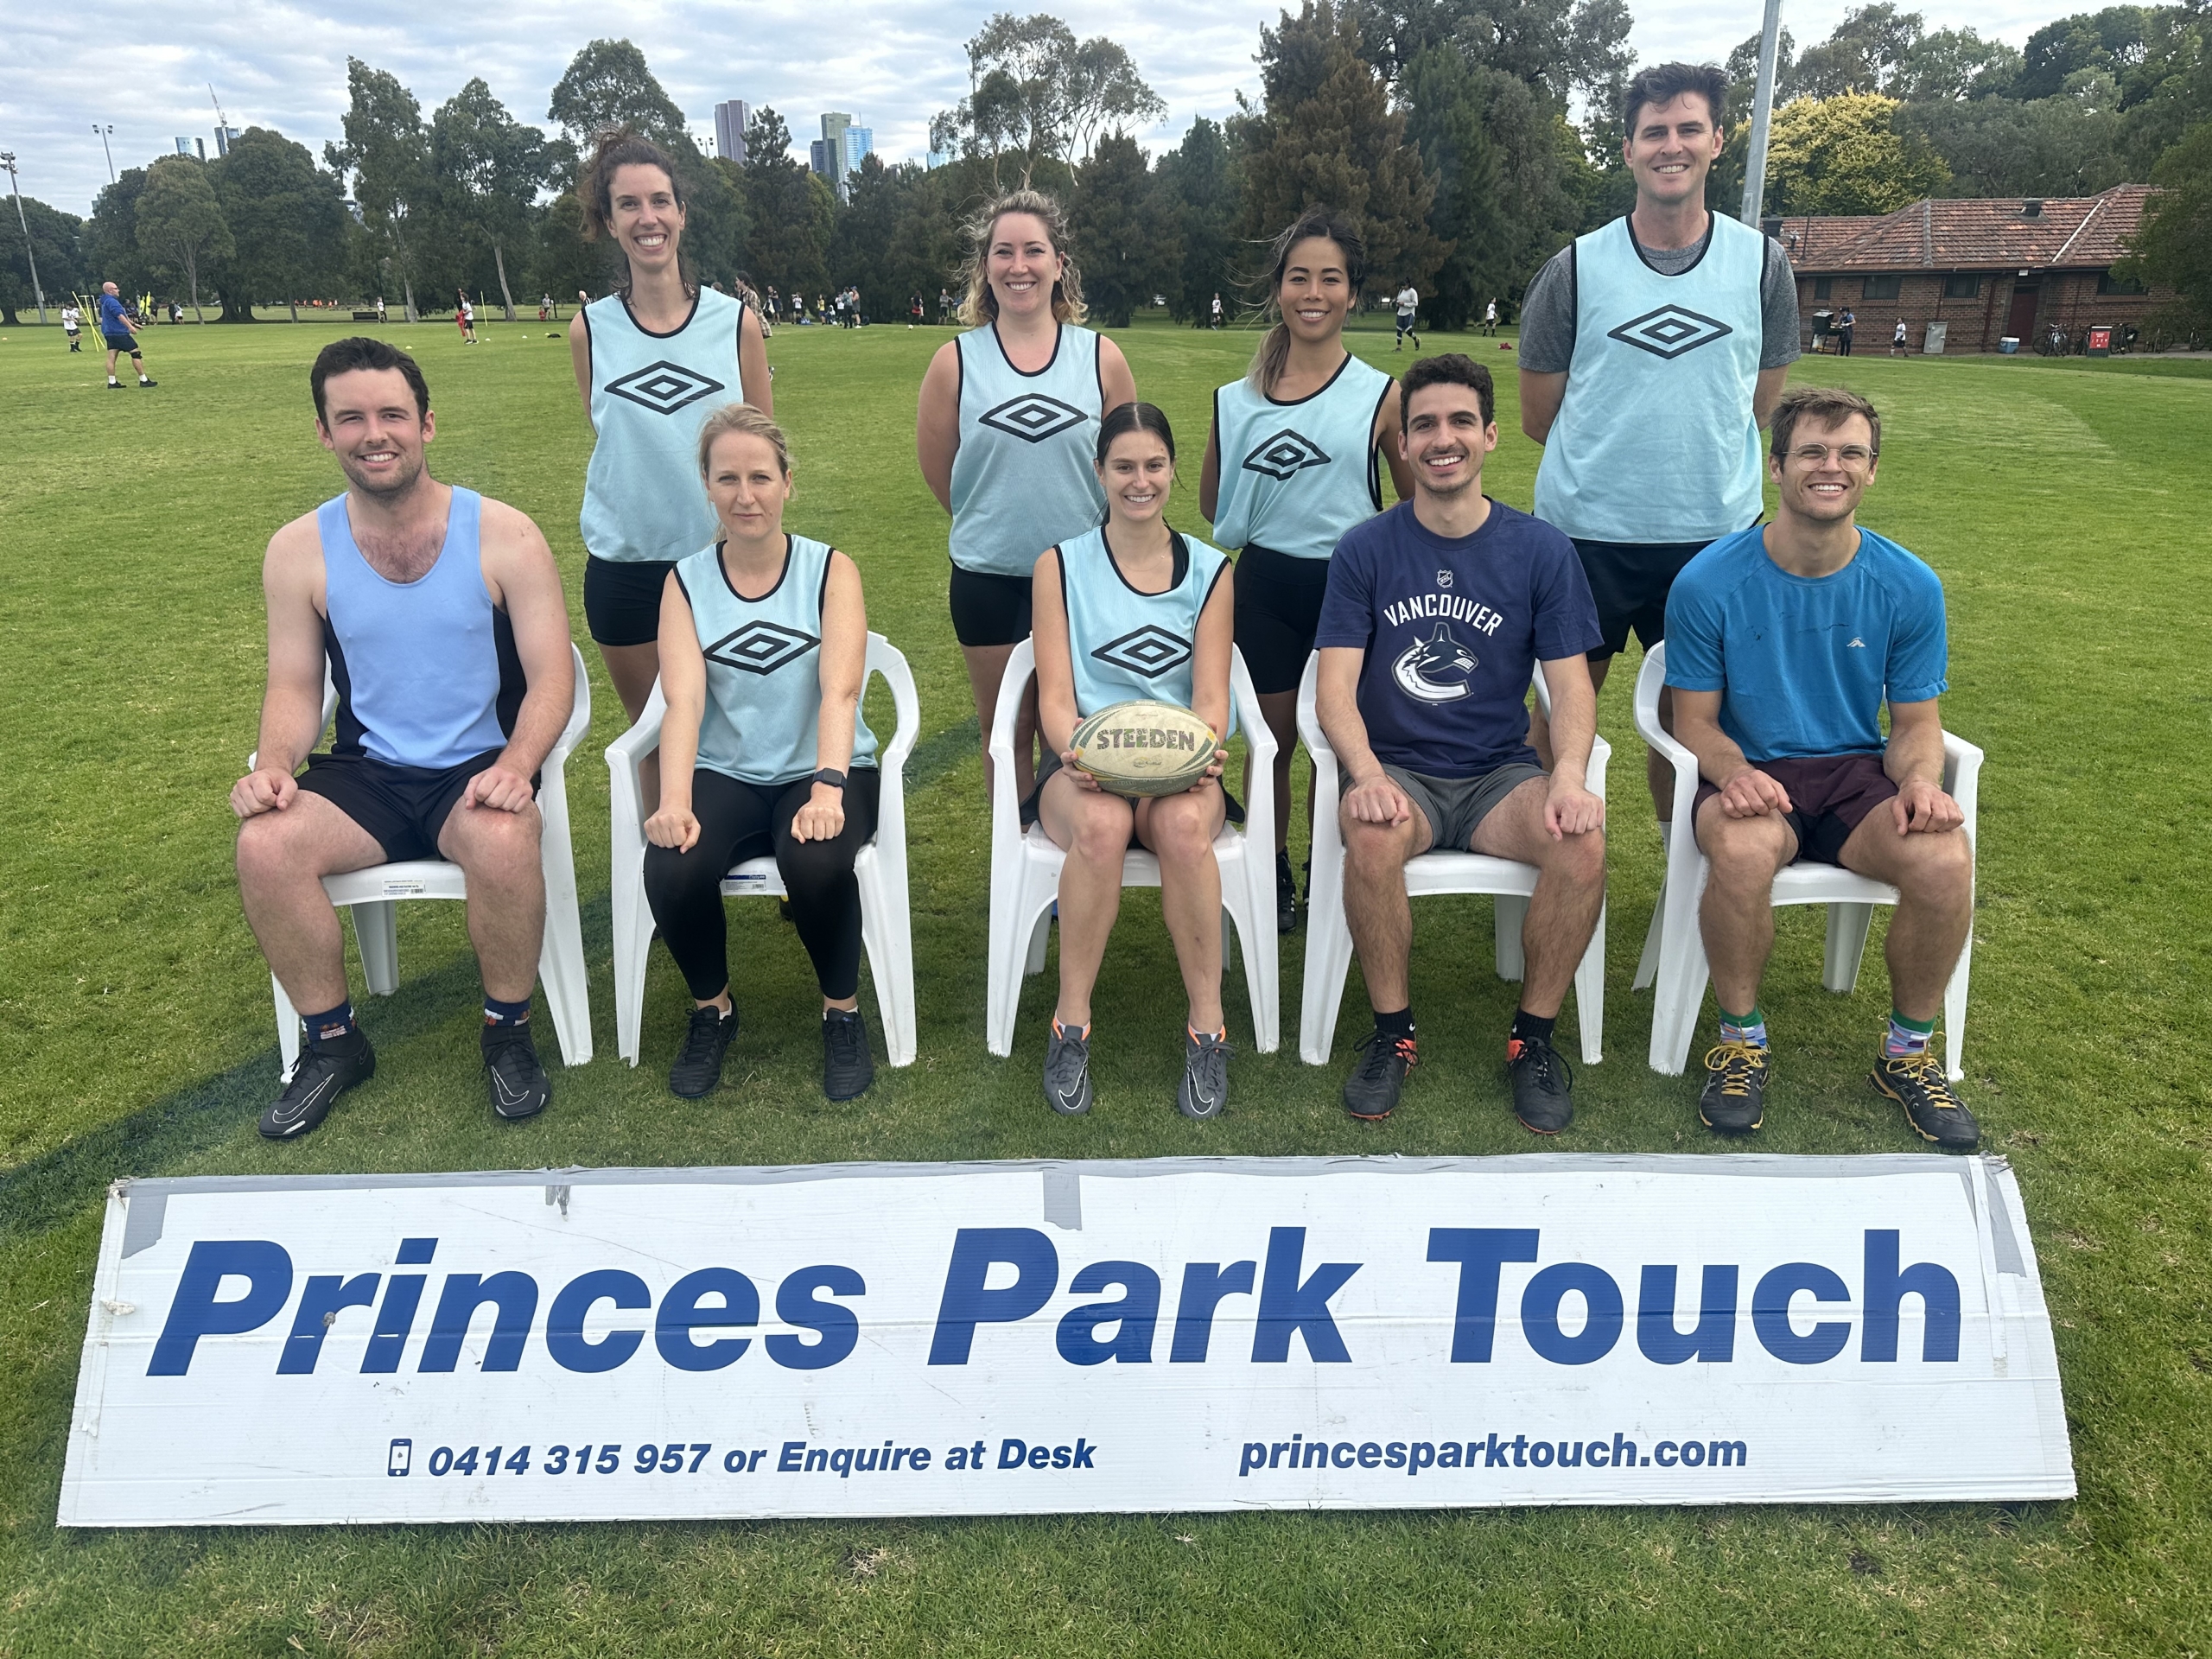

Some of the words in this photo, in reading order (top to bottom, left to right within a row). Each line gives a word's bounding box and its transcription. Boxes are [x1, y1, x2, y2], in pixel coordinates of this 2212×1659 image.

[1383, 594, 1503, 637] VANCOUVER
[1097, 728, 1194, 751] STEEDEN
[146, 1238, 865, 1376] Princes
[928, 1227, 1363, 1365] Park
[1427, 1228, 1961, 1364] Touch
[429, 1446, 530, 1476] 0414
[544, 1446, 620, 1474] 315
[635, 1444, 711, 1473] 957
[724, 1450, 767, 1472] or
[778, 1441, 931, 1478] Enquire
[945, 1441, 985, 1470] at
[998, 1439, 1096, 1469] Desk
[1240, 1433, 1746, 1476] princesparktouch.com
